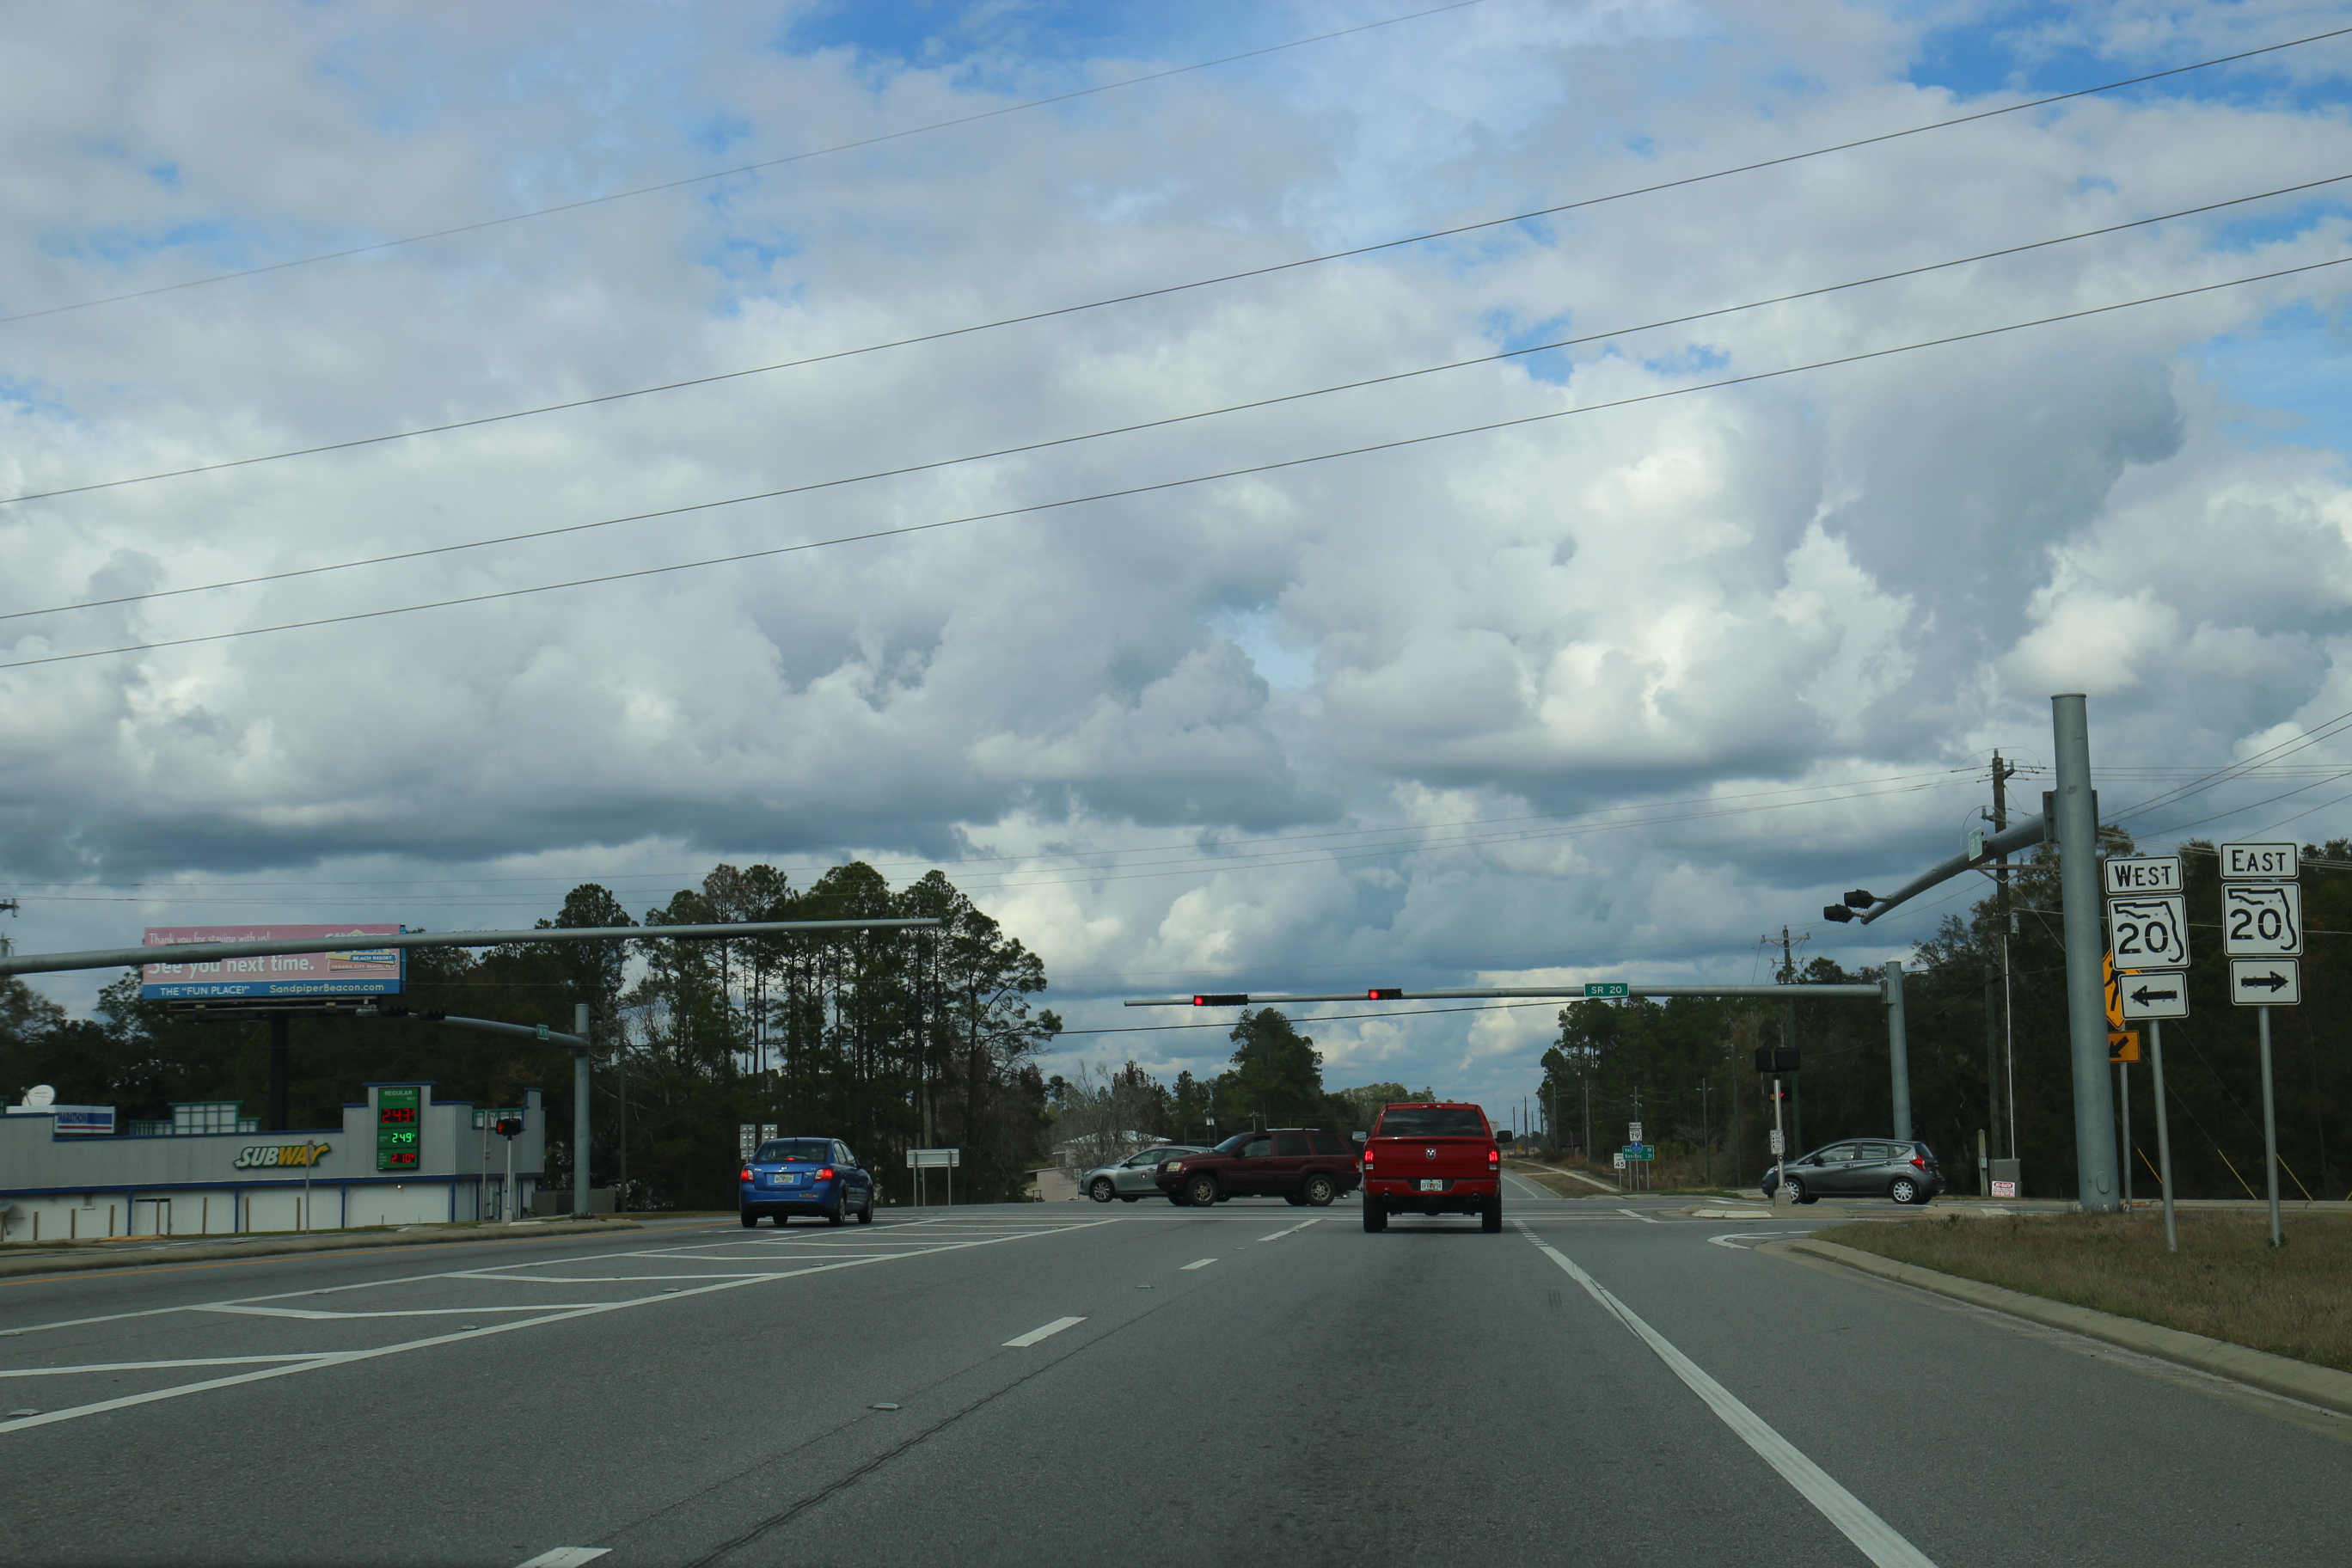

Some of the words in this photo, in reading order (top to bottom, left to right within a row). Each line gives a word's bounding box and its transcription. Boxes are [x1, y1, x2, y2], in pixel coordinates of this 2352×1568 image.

[2232, 849, 2287, 872] EAST
[2114, 864, 2171, 887] WEST
[2229, 908, 2282, 940] 20
[149, 933, 175, 945] Thank
[238, 931, 255, 942] with
[2116, 921, 2169, 955] 20
[189, 961, 220, 979] you
[226, 956, 265, 972] next
[271, 955, 315, 971] time.
[160, 988, 180, 996] THE
[269, 983, 384, 994] SandpiperBeacon.com
[234, 1144, 329, 1167] SUBWAY
